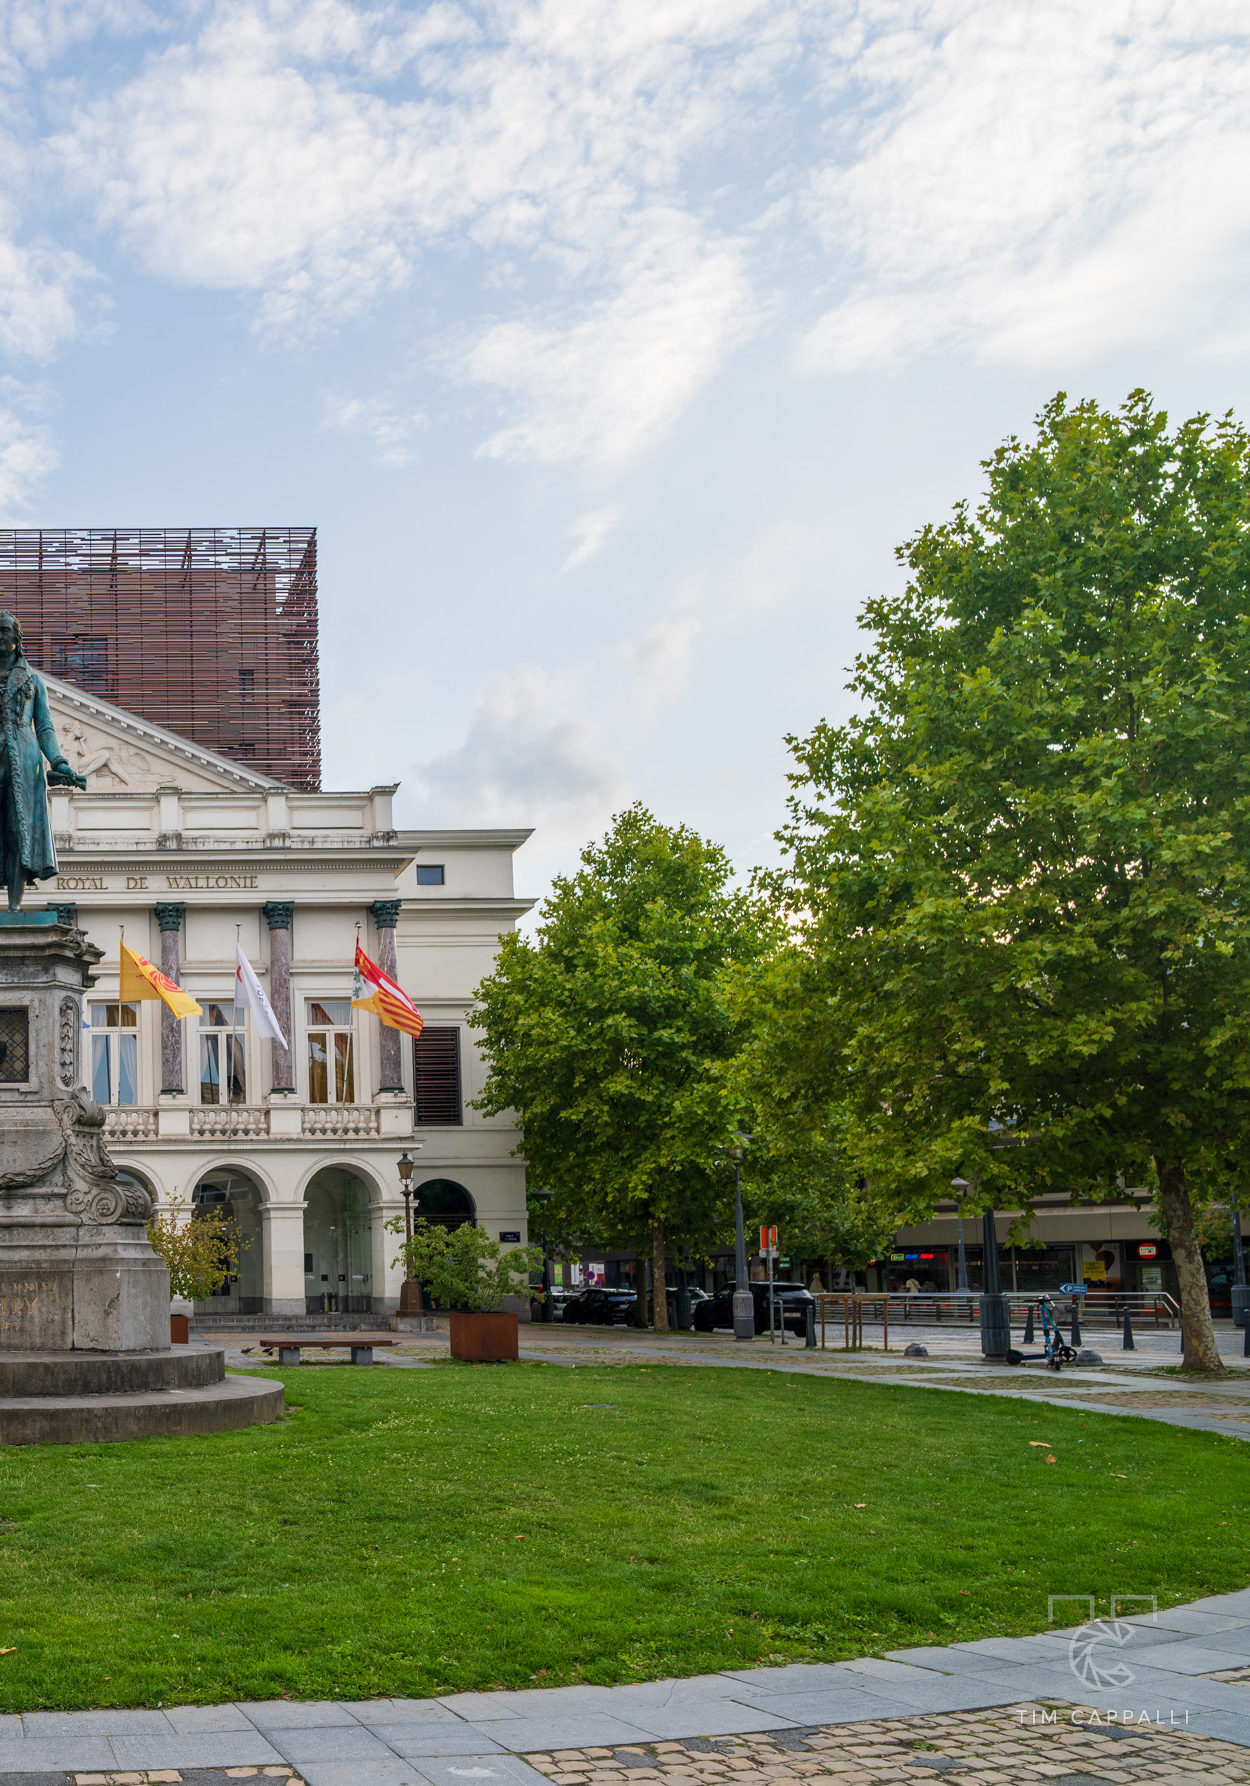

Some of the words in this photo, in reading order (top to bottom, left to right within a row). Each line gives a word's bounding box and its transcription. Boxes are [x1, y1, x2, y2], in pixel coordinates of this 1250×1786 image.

[55, 877, 109, 890] ROYAL
[125, 877, 148, 890] DE
[166, 876, 259, 889] WALLONIE
